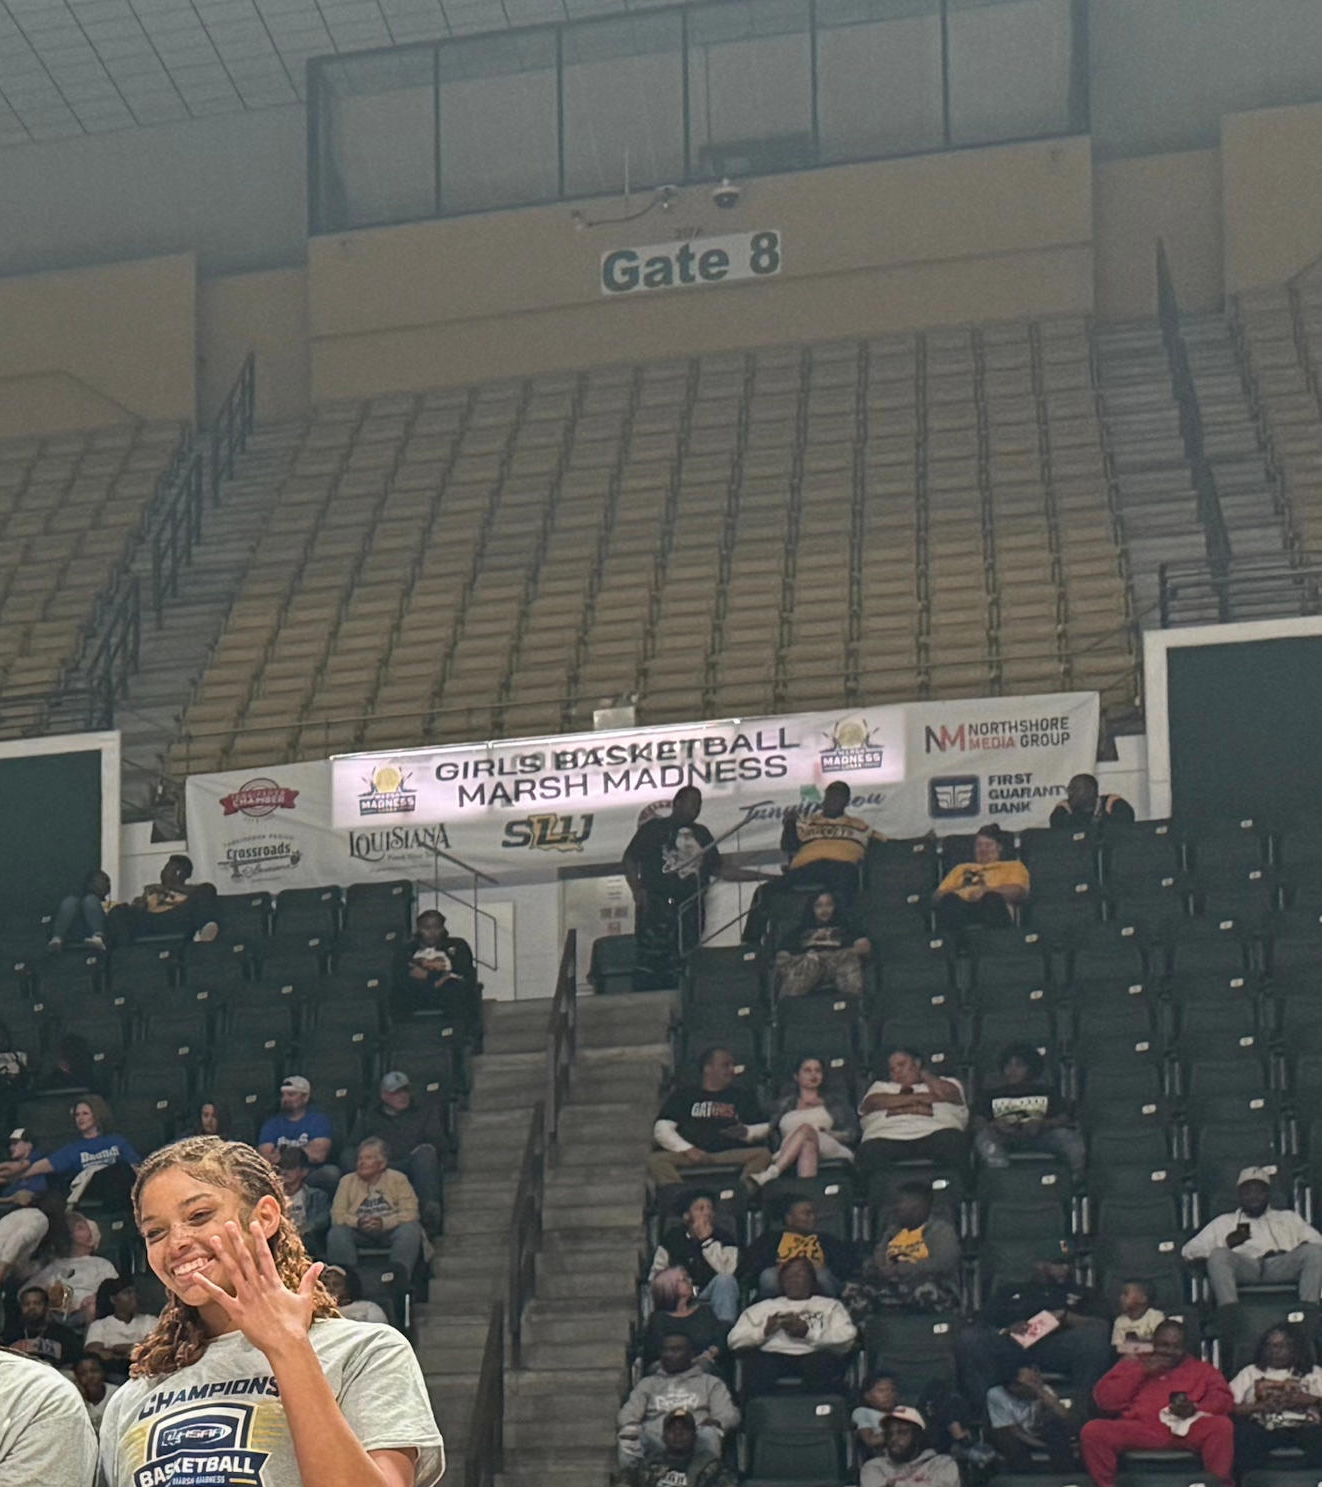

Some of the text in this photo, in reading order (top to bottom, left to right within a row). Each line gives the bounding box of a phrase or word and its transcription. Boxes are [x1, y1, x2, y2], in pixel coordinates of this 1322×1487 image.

[603, 231, 779, 292] Gate 8
[968, 707, 1069, 736] NORTHSHORE
[969, 731, 1070, 751] MEDIA GROUP
[435, 727, 800, 781] GIRLS BASKETBALL
[822, 752, 882, 766] MADNESS
[458, 755, 788, 807] MARSH MADNESS
[988, 773, 1034, 786] FIRST
[360, 796, 414, 811] MADNESS
[989, 801, 1032, 815] BANK
[226, 841, 292, 861] Crossroads
[349, 822, 452, 862] LOUISIANA
[139, 1376, 279, 1421] CHAMPIONS
